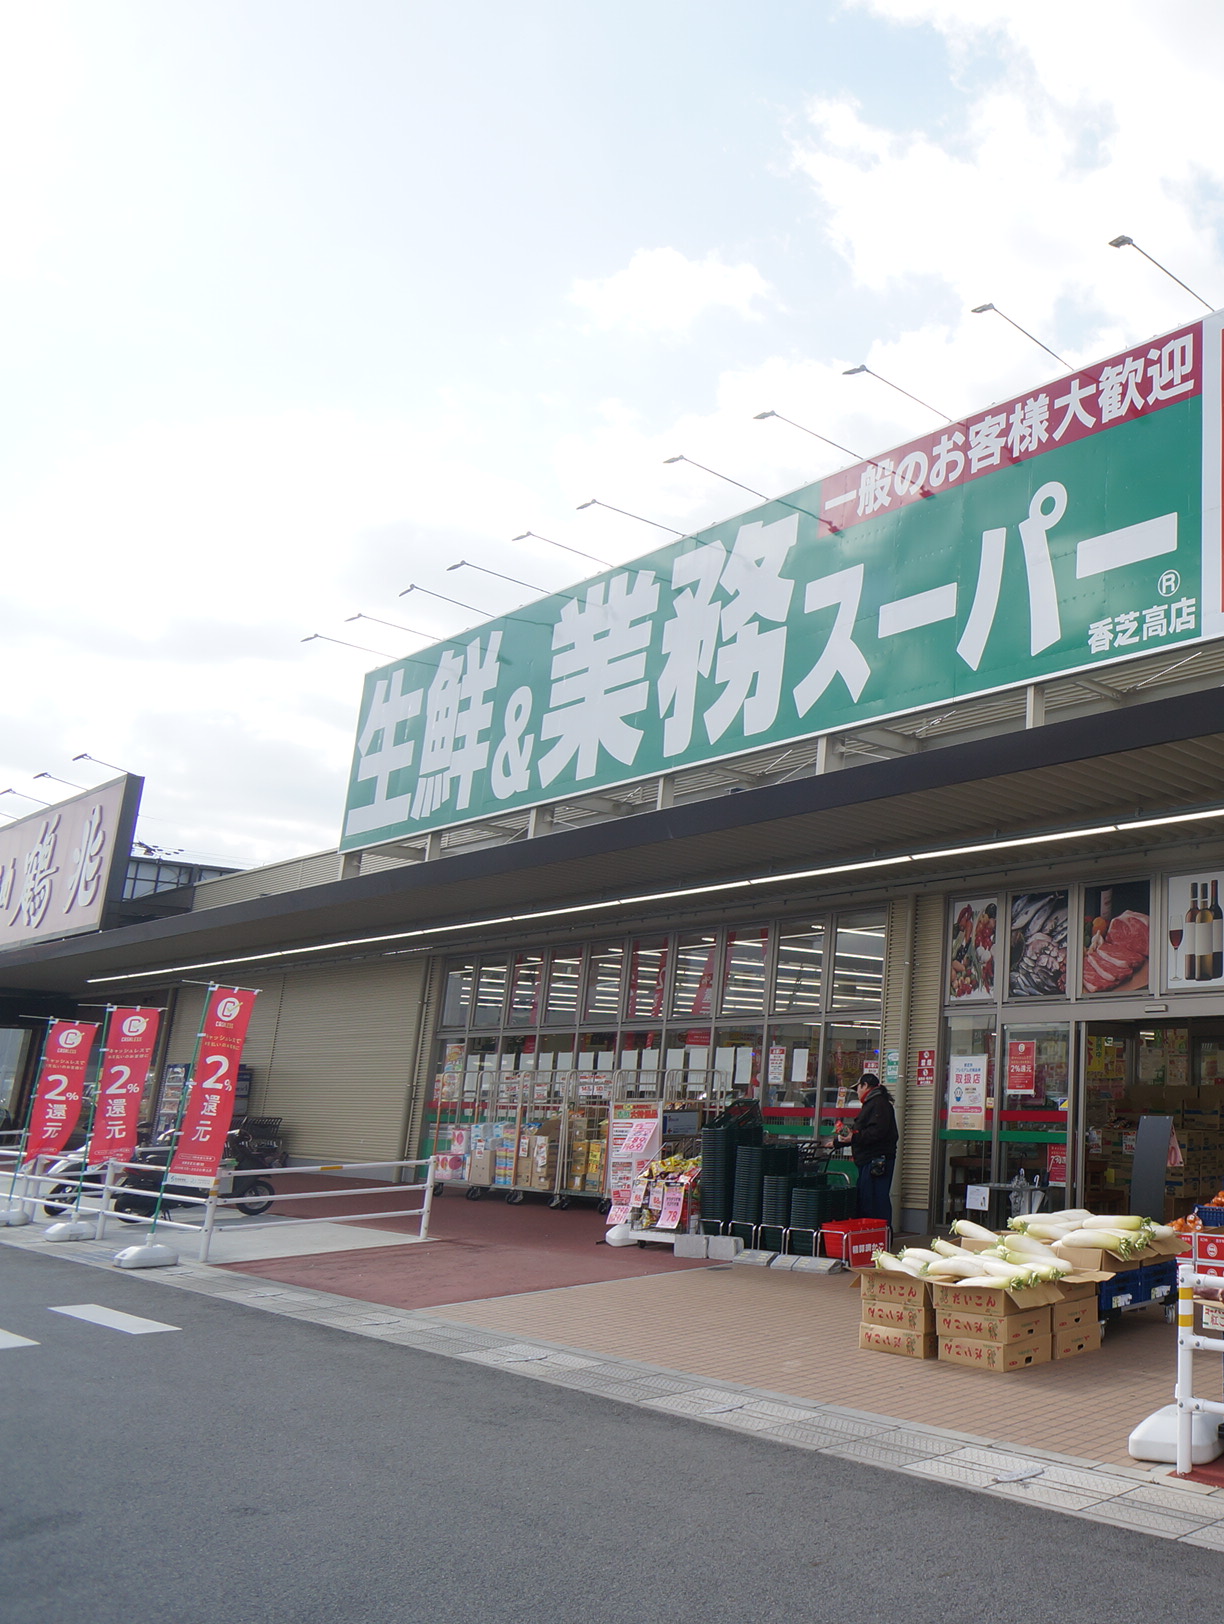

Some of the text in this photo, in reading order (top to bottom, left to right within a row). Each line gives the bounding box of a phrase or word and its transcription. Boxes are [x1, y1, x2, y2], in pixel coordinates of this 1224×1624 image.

[824, 337, 1195, 519] 一般のお客様大歓迎
[1087, 597, 1196, 654] 香芝高店
[346, 481, 1178, 832] 生鮮&業務スーパー
[202, 1055, 232, 1092] 2%
[955, 1073, 981, 1084] 取扱店
[1010, 1064, 1033, 1073] 2%還元
[44, 1074, 79, 1101] 2%
[105, 1065, 140, 1095] 2%
[41, 1103, 67, 1139] 還元
[105, 1098, 127, 1140] 還元
[191, 1095, 221, 1142] 還元
[667, 1210, 678, 1221] 78
[878, 1282, 917, 1298] だいこん
[953, 1292, 997, 1308] だいこん
[867, 1306, 904, 1322] だいこん
[942, 1317, 983, 1333] だいこん
[864, 1331, 902, 1348] だいこん
[944, 1342, 983, 1360] だいこん
